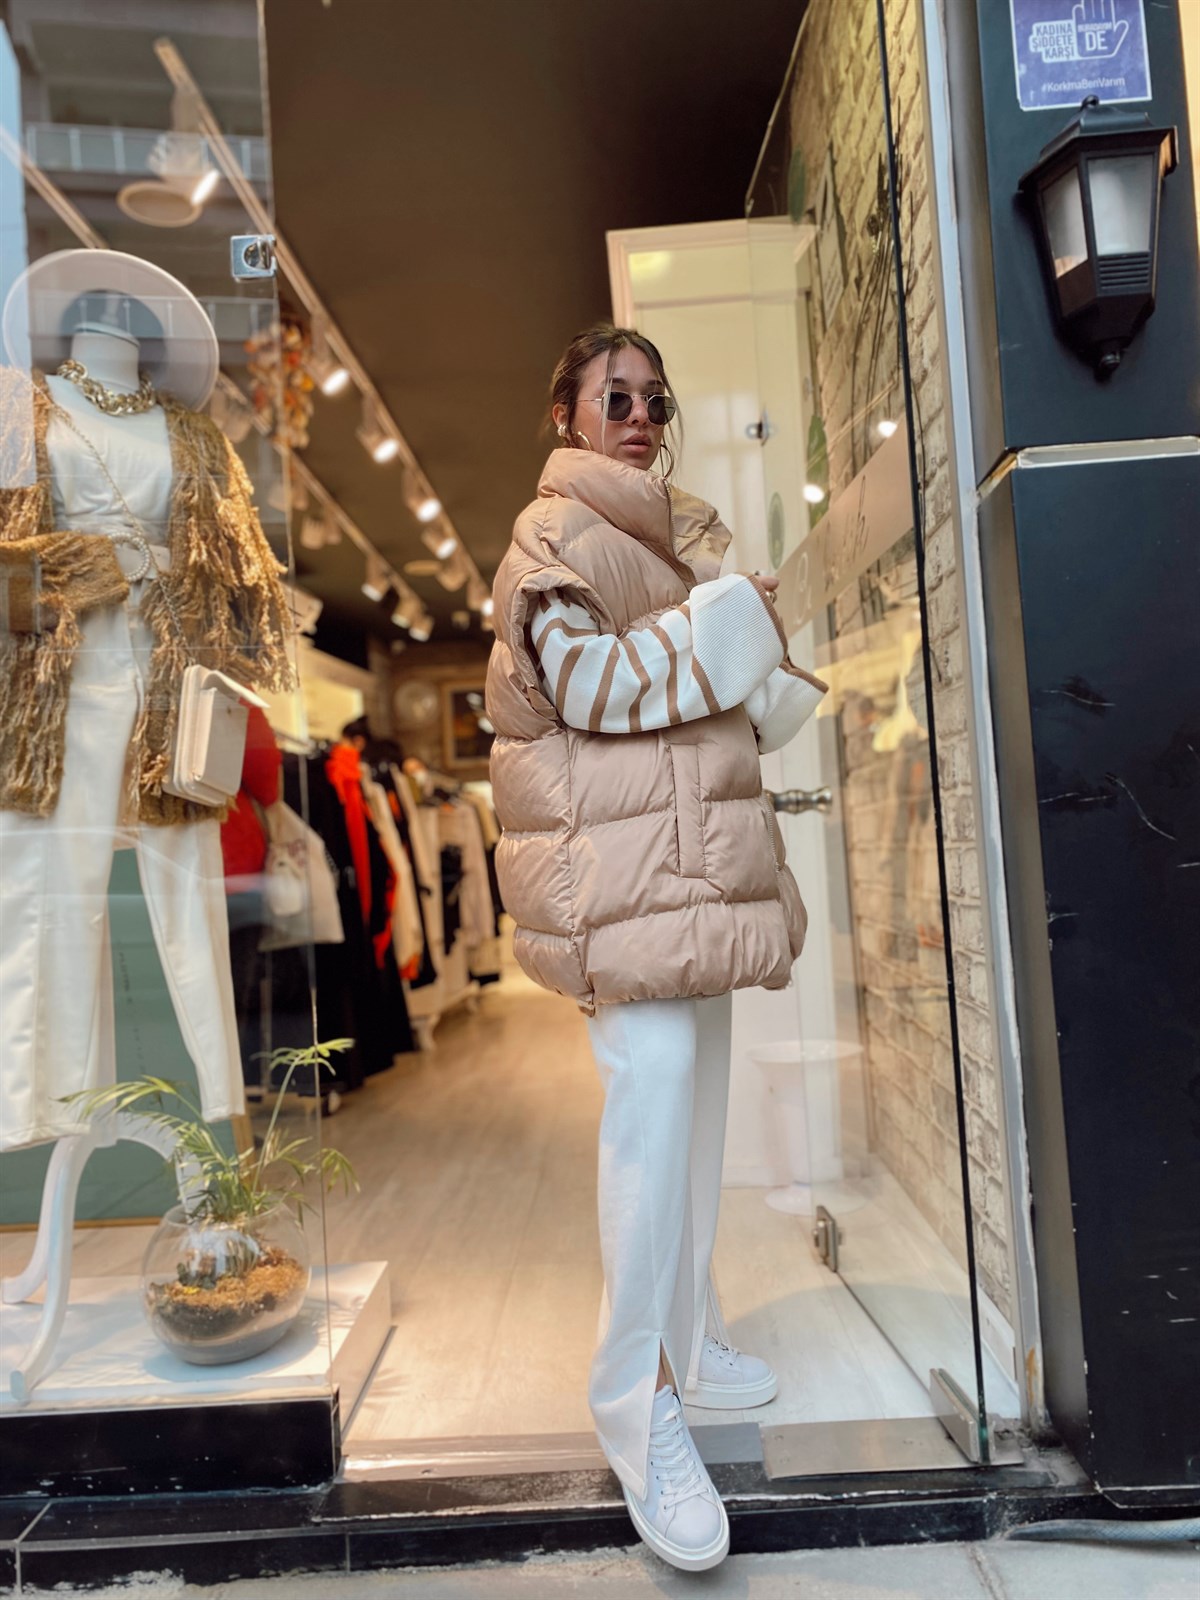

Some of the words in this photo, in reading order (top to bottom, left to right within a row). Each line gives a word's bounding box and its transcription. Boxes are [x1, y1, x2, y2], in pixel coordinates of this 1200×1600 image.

[1036, 23, 1073, 37] KADINA
[1085, 30, 1108, 51] DE
[1045, 46, 1074, 60] KARŞI
